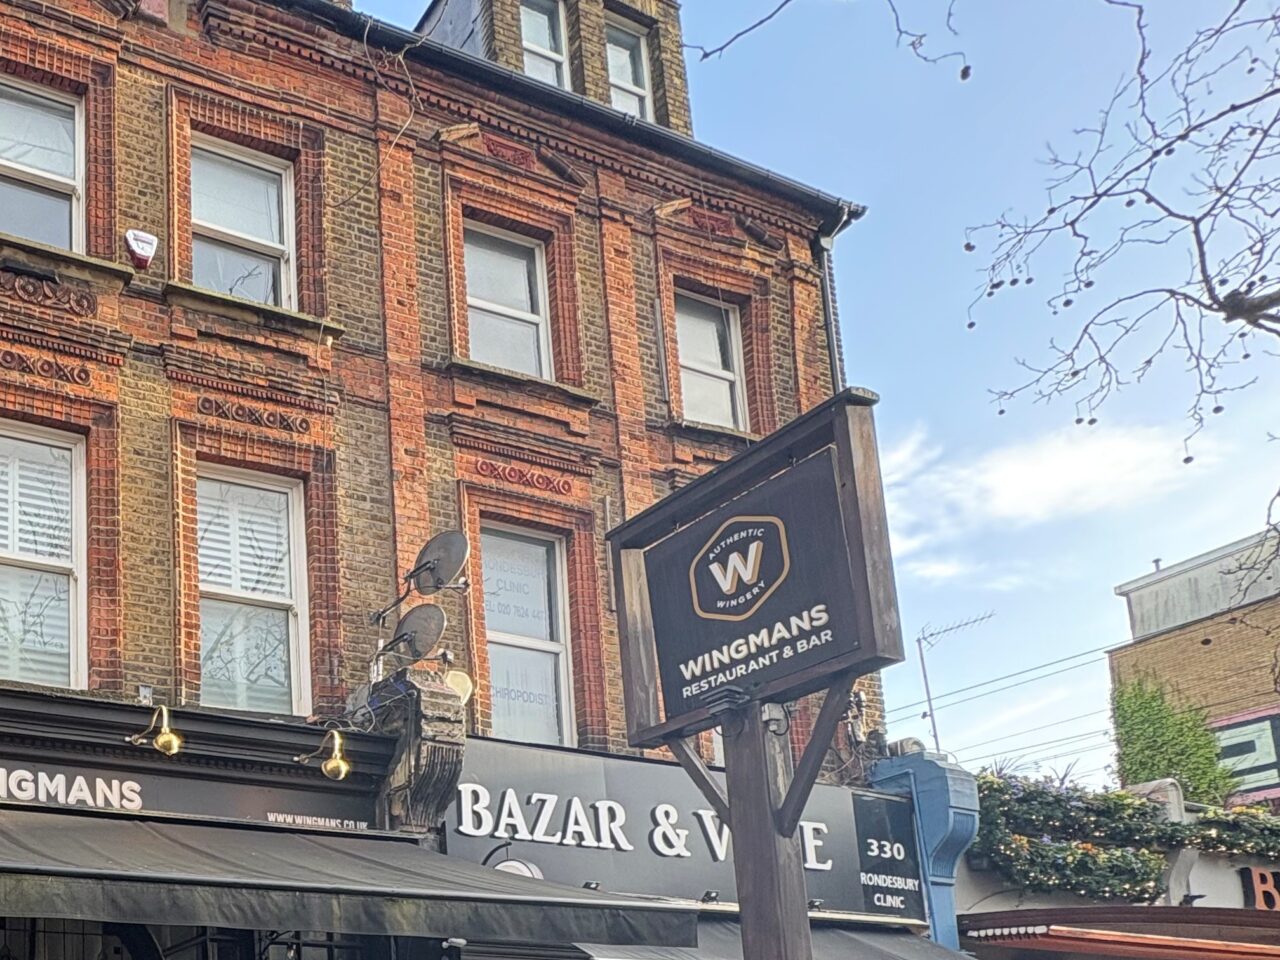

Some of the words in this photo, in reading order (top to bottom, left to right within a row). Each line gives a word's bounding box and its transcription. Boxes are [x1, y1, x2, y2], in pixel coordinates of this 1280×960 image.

[708, 528, 765, 560] AUTHENTIC
[708, 540, 764, 595] W
[716, 580, 765, 608] WINGERY
[679, 604, 829, 681] WINGMANS
[682, 650, 779, 698] RESTAURANT
[782, 645, 794, 659] &
[796, 629, 833, 653] BAR
[267, 812, 369, 831] WWWWINGMANSCOUK
[457, 783, 634, 851] BAZAR
[652, 803, 692, 857] &
[696, 809, 833, 871] VE
[867, 838, 905, 861] 330
[873, 893, 906, 909] CLINIC
